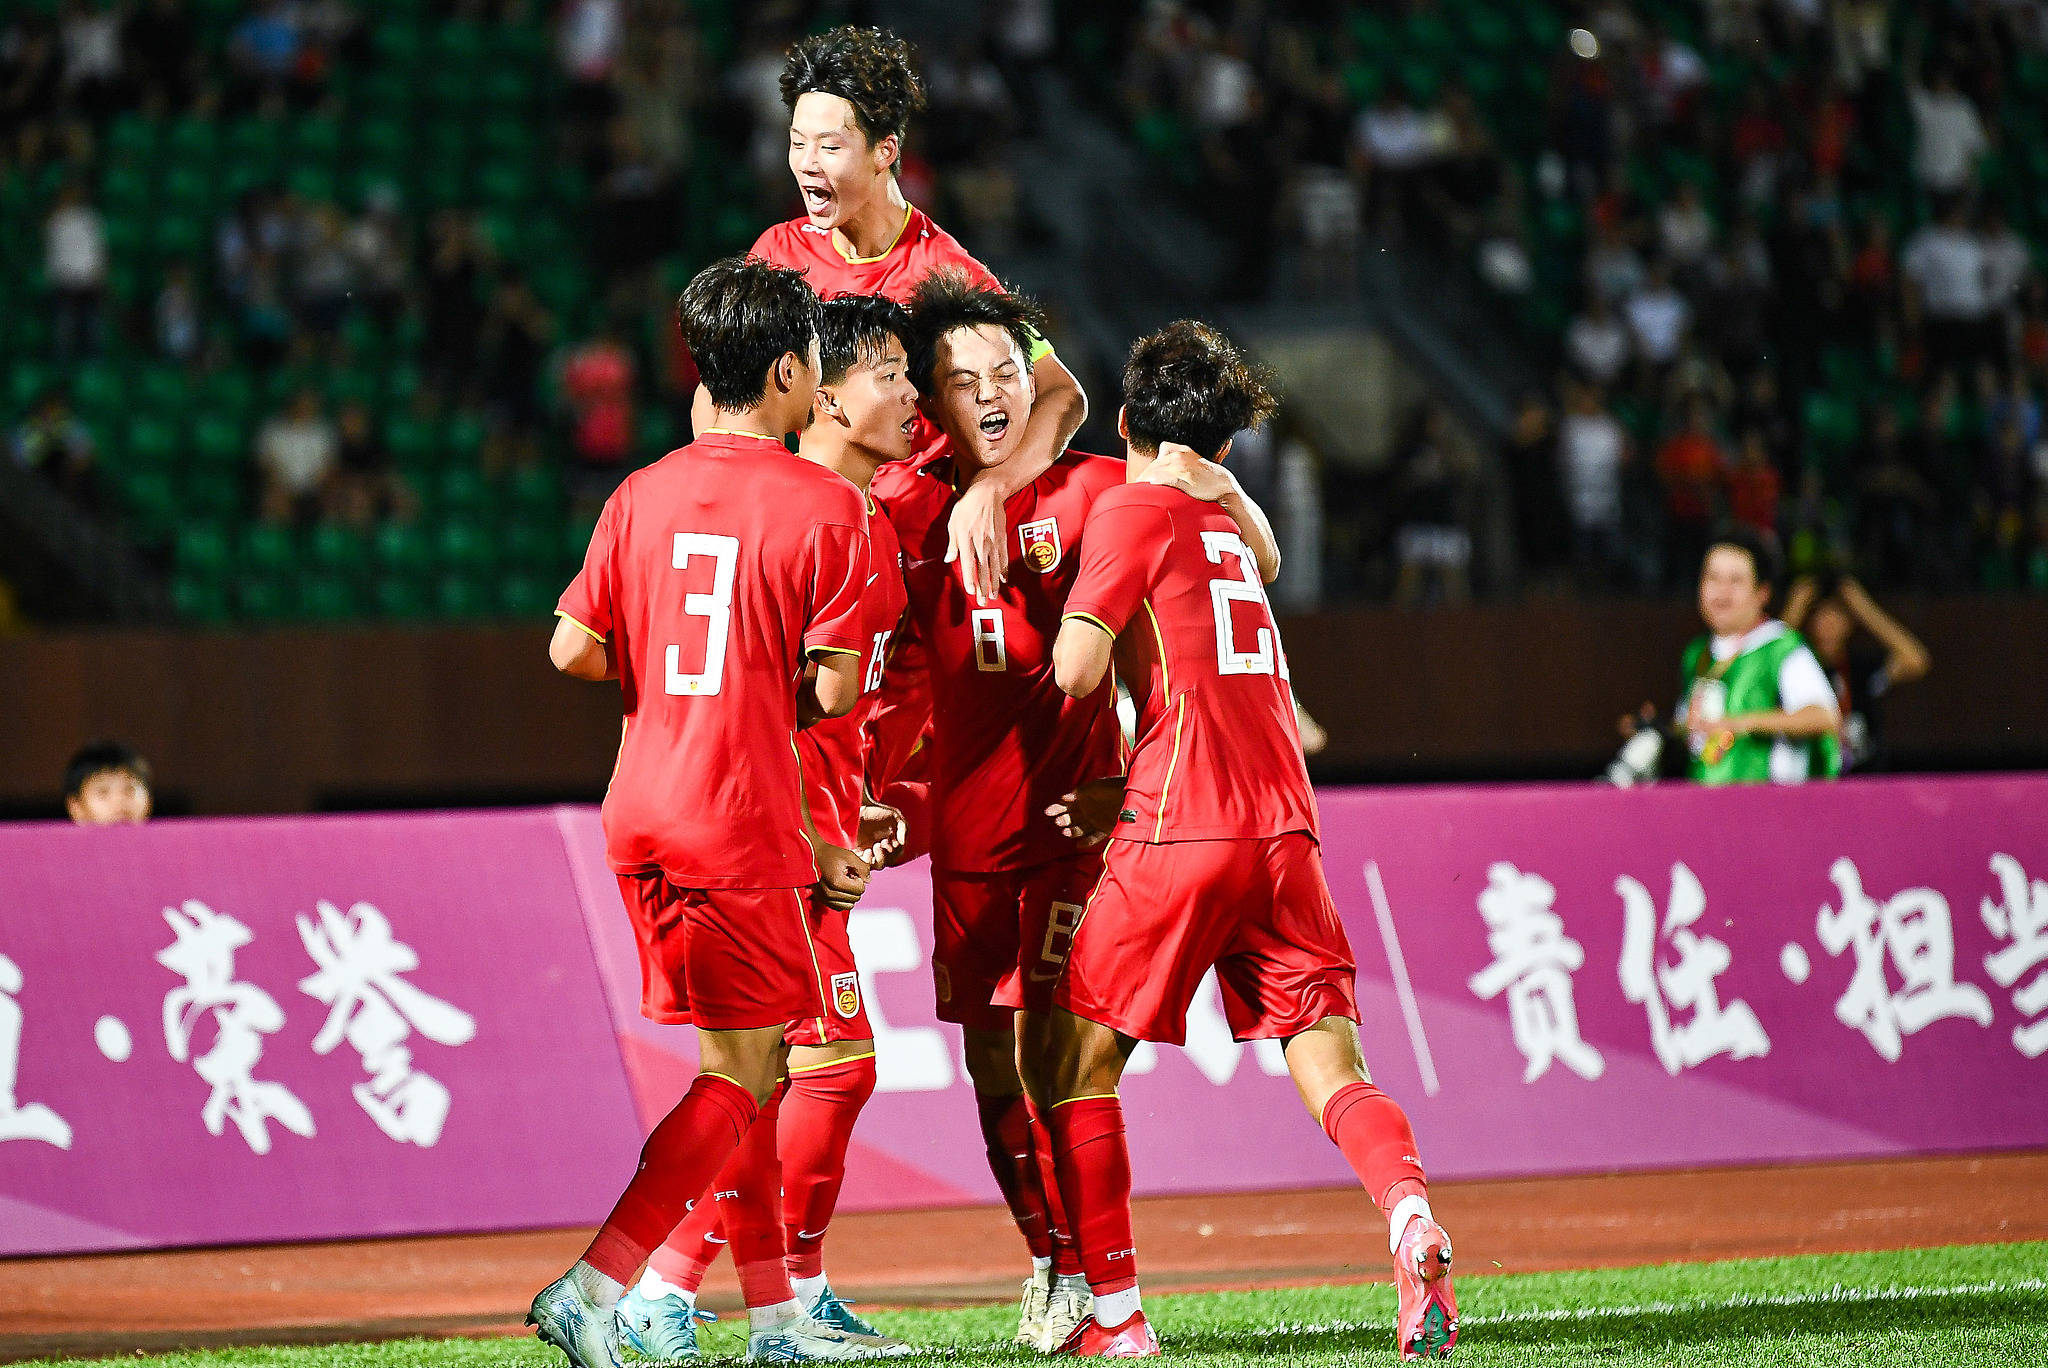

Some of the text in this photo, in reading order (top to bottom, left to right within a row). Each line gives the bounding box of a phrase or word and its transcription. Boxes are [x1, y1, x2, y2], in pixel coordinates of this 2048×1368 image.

[664, 532, 740, 696] 3
[971, 608, 1007, 672] 8
[864, 630, 893, 694] 15
[714, 1190, 739, 1202] FA
